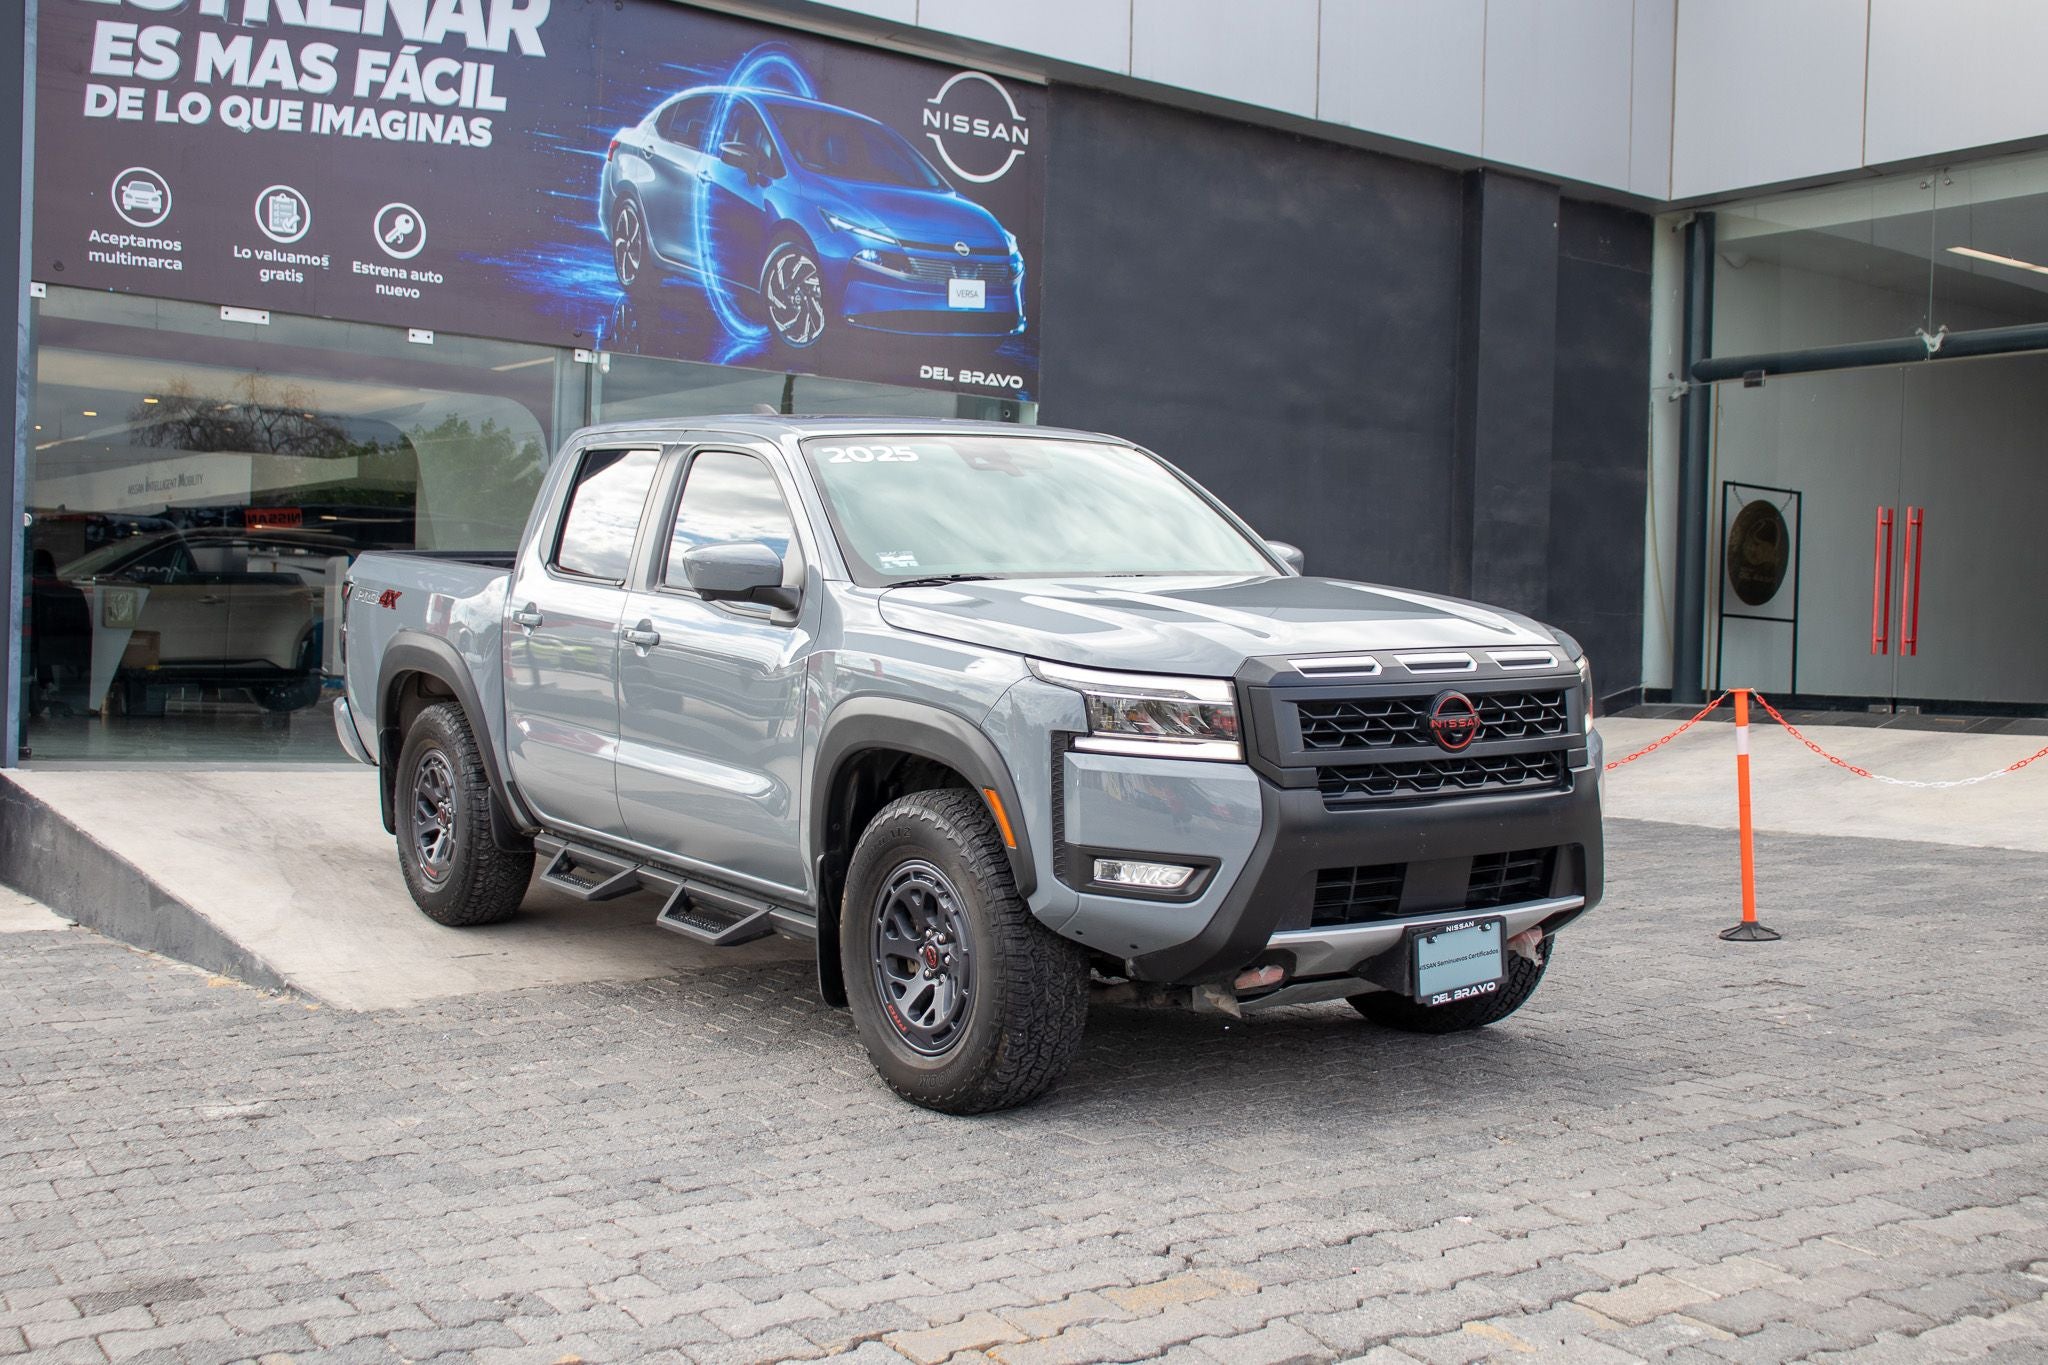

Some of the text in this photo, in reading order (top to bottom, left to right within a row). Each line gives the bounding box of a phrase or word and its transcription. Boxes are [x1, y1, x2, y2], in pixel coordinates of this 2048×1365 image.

[90, 20, 182, 81] ES
[194, 31, 339, 95] MAS
[353, 45, 507, 112] FÁCIL
[84, 83, 493, 148] DE LO QUE IMAGINAS
[923, 108, 1029, 146] NISSAN
[89, 229, 182, 251] Aceptamos
[89, 251, 183, 271] multimarca
[233, 245, 330, 267] Lo valuamos
[260, 268, 304, 283] gratis
[352, 261, 444, 284] Estrena auto
[376, 284, 420, 299] nuevo
[956, 290, 979, 298] VERSA
[920, 365, 1024, 389] DEL BRAVO
[822, 446, 919, 464] 2025
[1445, 921, 1475, 932] NISSAN
[1437, 956, 1468, 967] Seminuevos
[1468, 949, 1499, 960] Certificados
[1432, 982, 1496, 1005] DEL BRAVO
